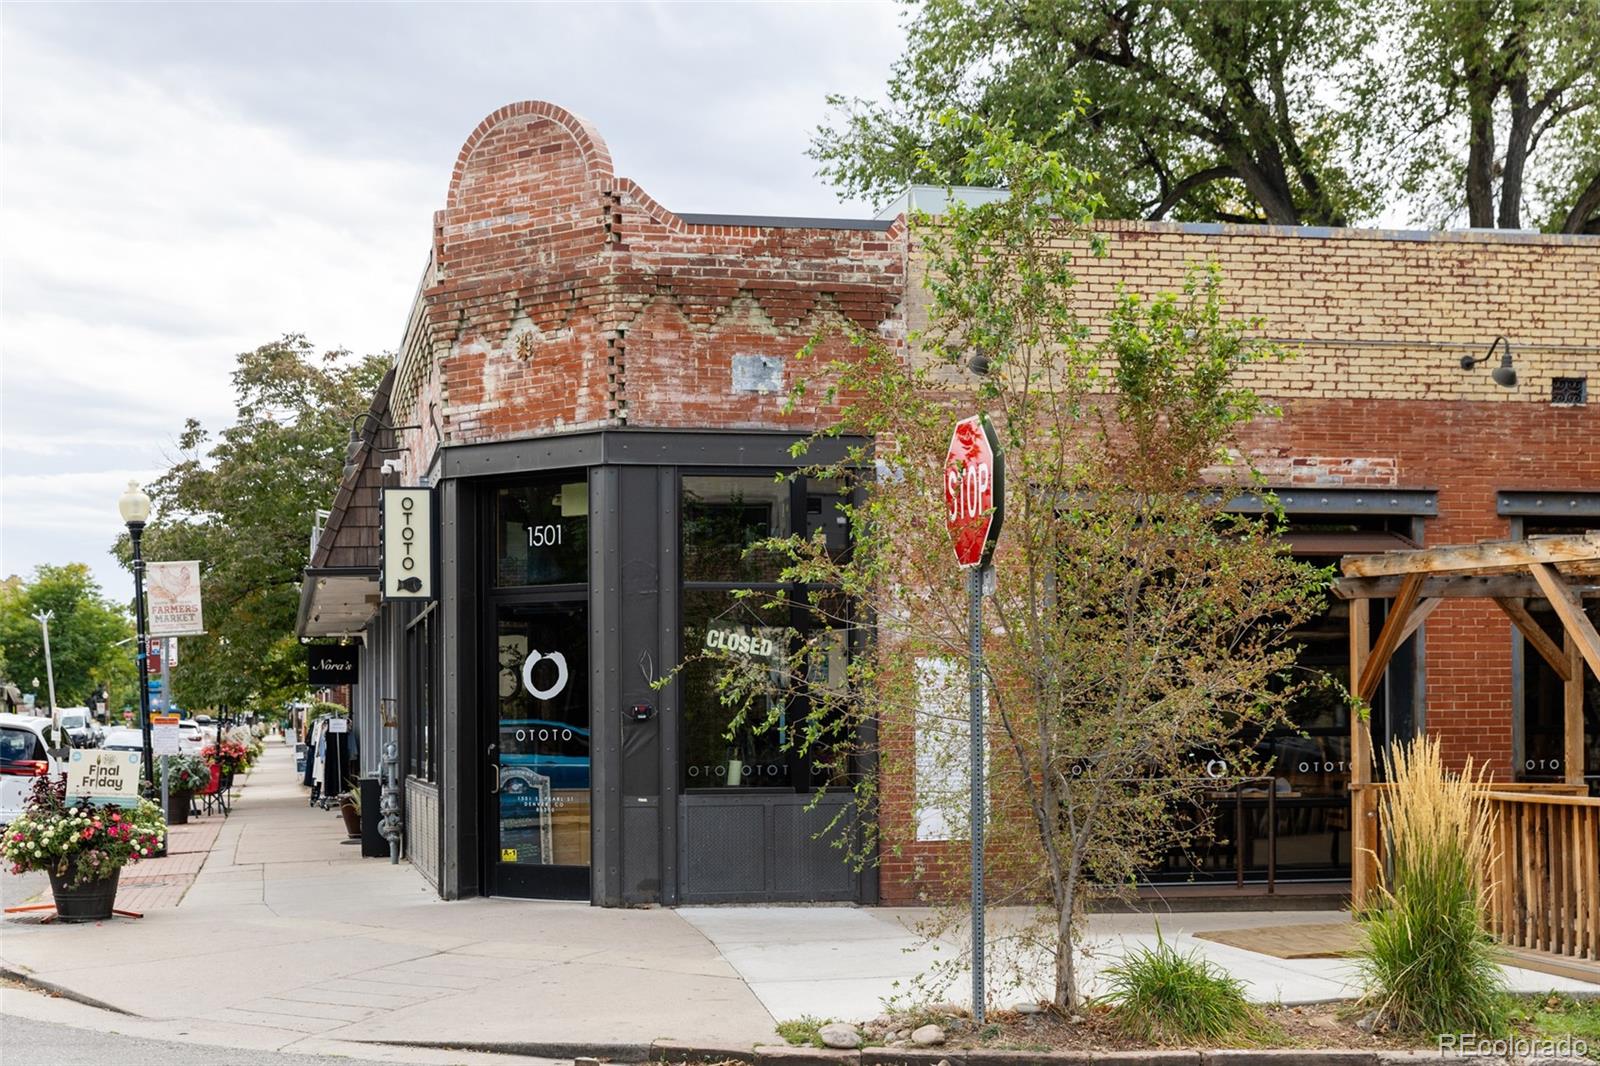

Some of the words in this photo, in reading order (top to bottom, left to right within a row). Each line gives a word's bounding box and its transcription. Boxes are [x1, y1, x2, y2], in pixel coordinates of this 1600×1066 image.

[948, 462, 988, 523] STOP
[401, 496, 415, 571] OTOTO
[527, 524, 562, 547] 1501
[152, 604, 199, 614] FARMERS
[154, 613, 196, 623] MARKET
[706, 629, 773, 657] CLOSED
[311, 658, 353, 672] Nora's
[515, 728, 572, 742] OTOTO
[88, 764, 120, 776] Final
[82, 776, 123, 791] Friday
